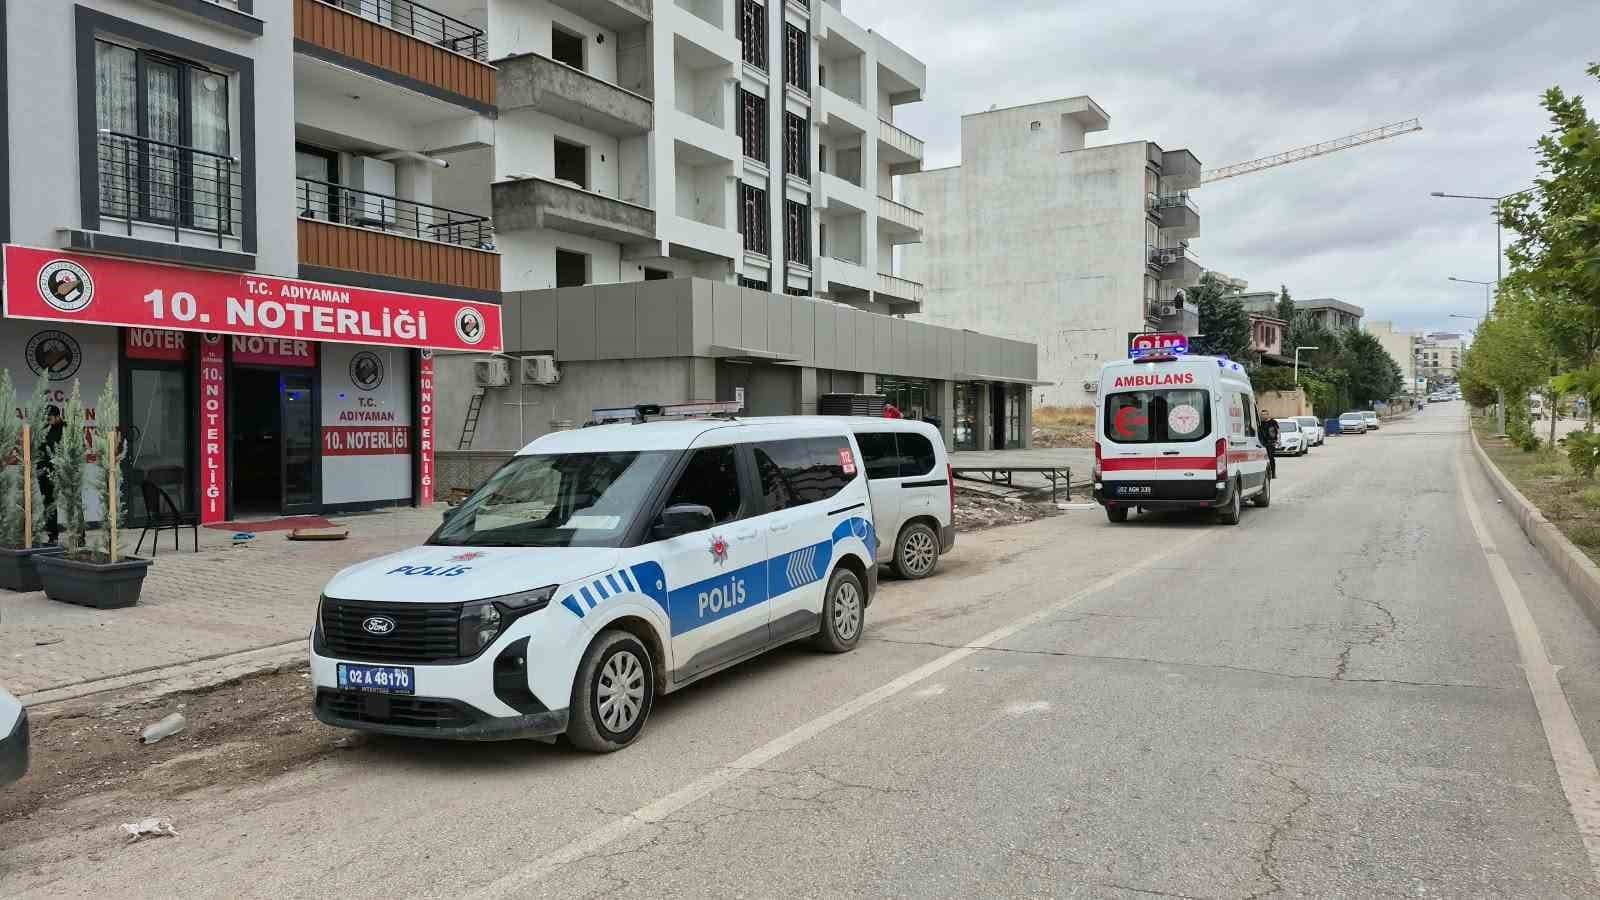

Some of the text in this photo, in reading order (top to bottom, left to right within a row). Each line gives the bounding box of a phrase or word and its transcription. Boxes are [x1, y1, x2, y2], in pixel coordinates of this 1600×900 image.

[247, 281, 350, 304] T.C. ADIYAMAN
[144, 289, 210, 323] 10.
[226, 297, 427, 340] NOTERLİĞİ
[130, 329, 185, 349] NOTER
[231, 337, 308, 357] NOTER
[203, 367, 222, 380] 10.
[1114, 373, 1193, 387] AMBULANS
[358, 397, 377, 408] T.C.
[339, 411, 395, 422] ADIYAMAN
[325, 430, 408, 449] 10. NOTERLİĞİ
[387, 565, 471, 576] POLİS
[698, 576, 746, 618] POLİS
[368, 619, 388, 631] Ford
[349, 670, 362, 683] 02
[365, 671, 372, 684] A
